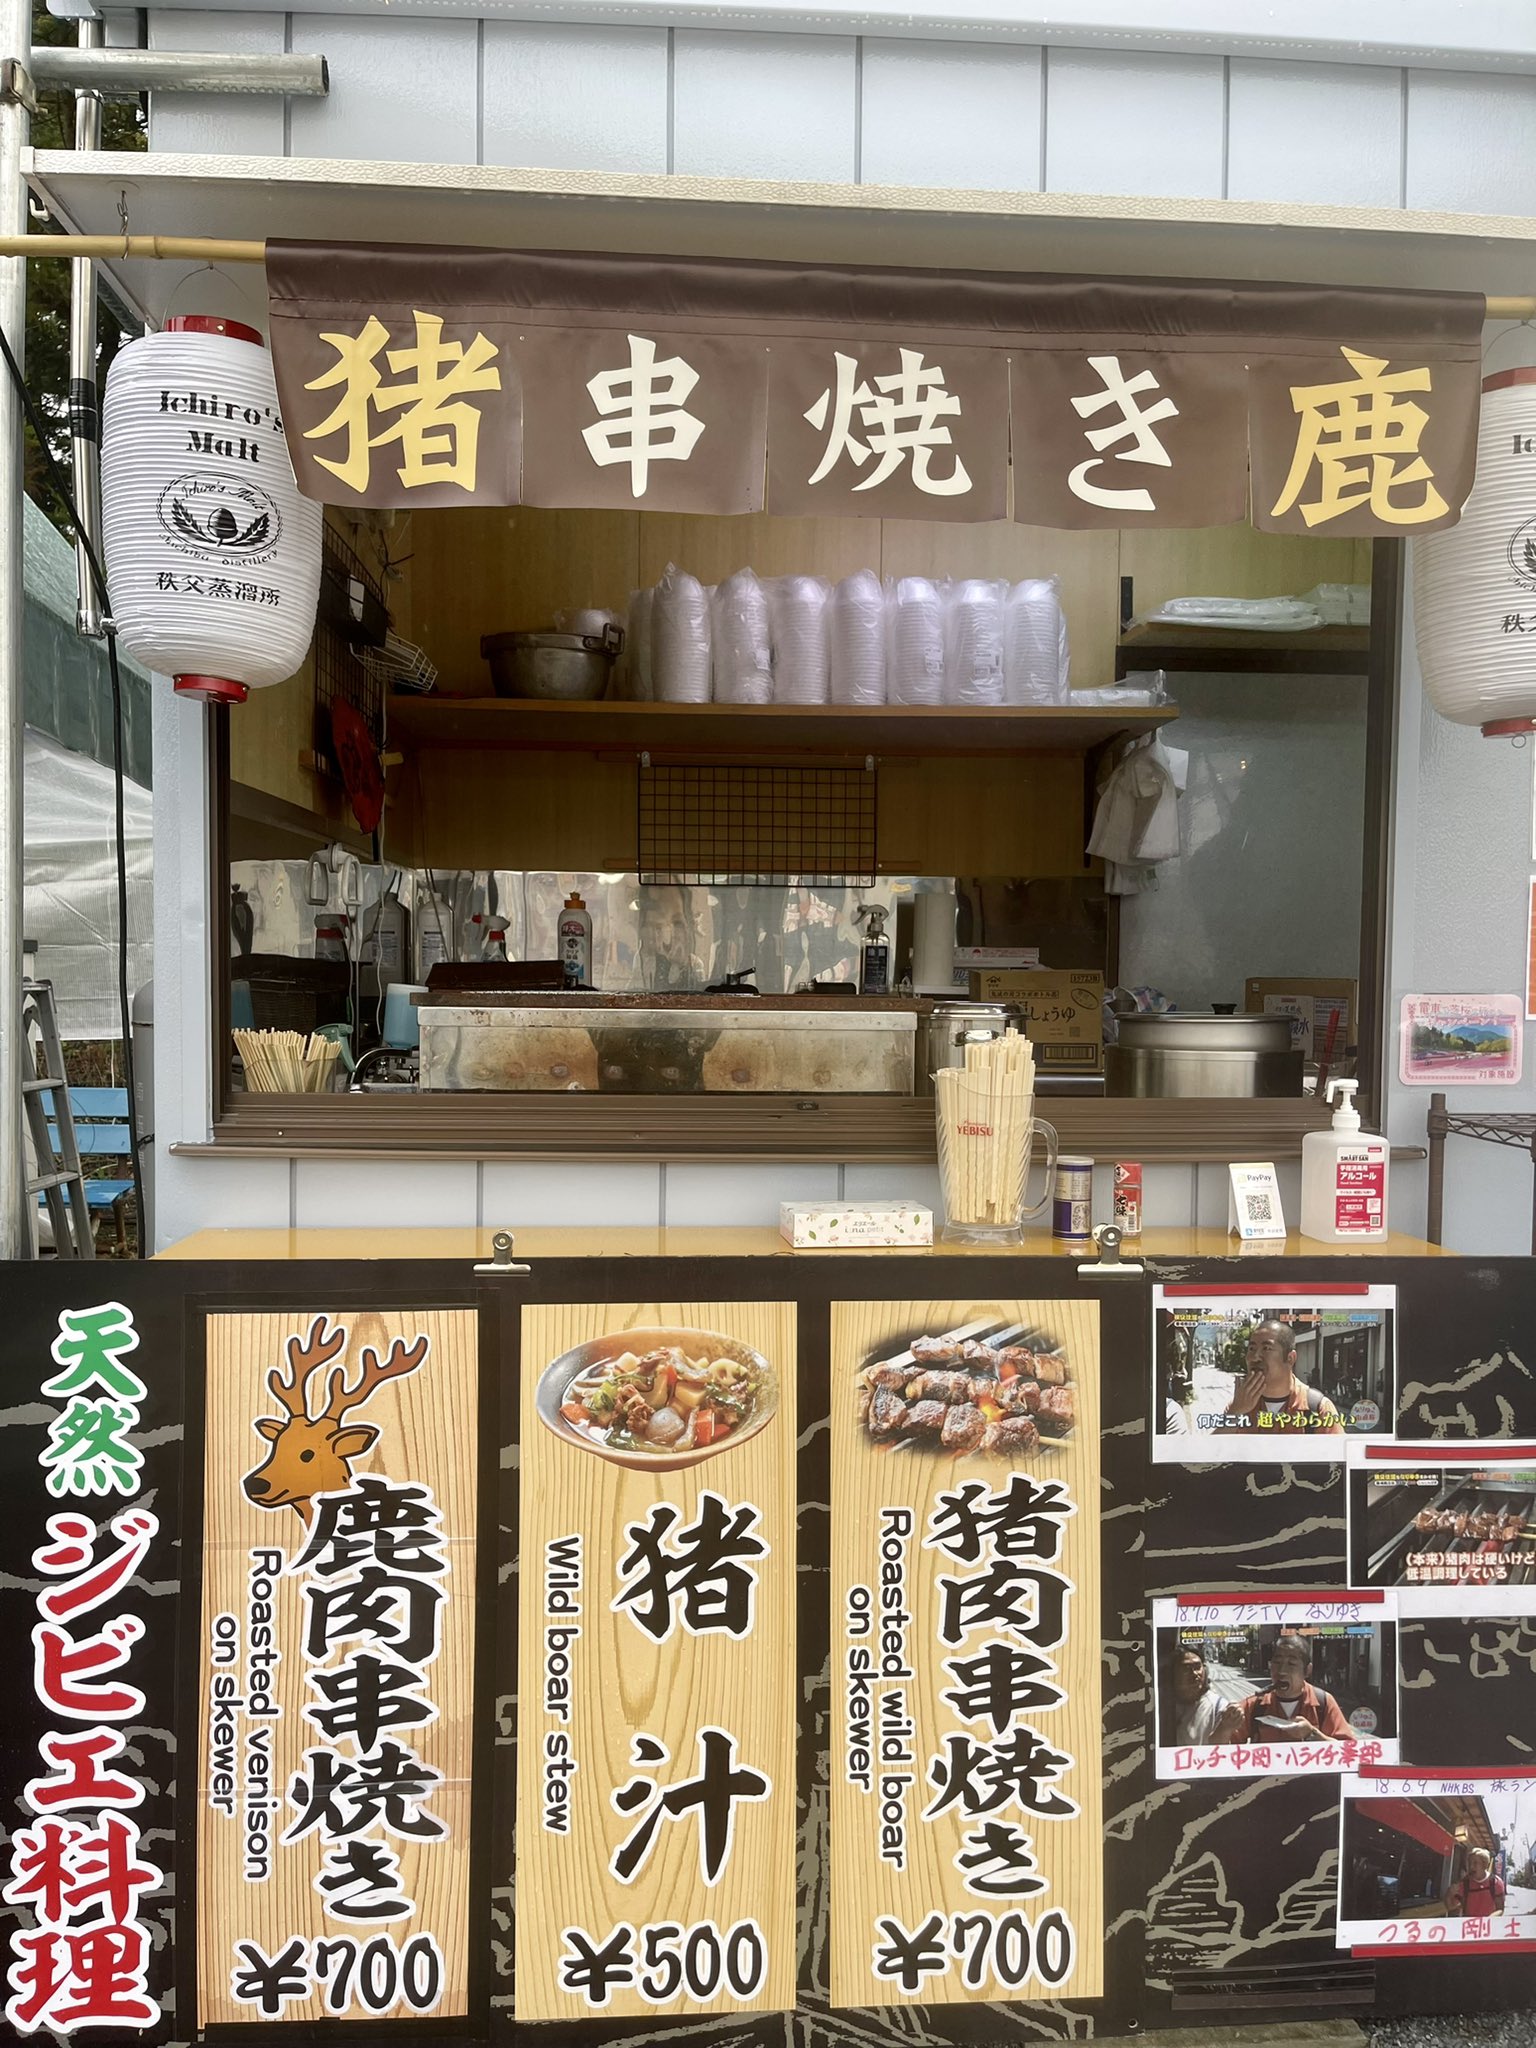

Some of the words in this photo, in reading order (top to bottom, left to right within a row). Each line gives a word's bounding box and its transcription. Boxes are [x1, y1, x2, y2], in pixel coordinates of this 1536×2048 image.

[159, 391, 284, 433] Ichiro's
[186, 430, 260, 463] Malt
[957, 1125, 994, 1137] YEBISU
[1247, 1174, 1272, 1182] PayPay
[1340, 1171, 1377, 1181] アルコール
[1198, 1415, 1252, 1429] 何だこれ
[1257, 1411, 1357, 1429] 超やわらかい
[548, 1538, 579, 1614] Wild
[849, 1587, 870, 1635] on
[881, 1510, 912, 1678] Roasted
[1406, 1566, 1508, 1581] 低温調理している
[215, 1616, 237, 1663] on
[249, 1550, 282, 1716] Roasted
[1175, 1605, 1220, 1623] 18.7.10
[1305, 1602, 1362, 1622] なりゆき
[6, 1304, 162, 2028] 天然ジビエ料理
[287, 1477, 446, 1918] 鹿肉串焼き
[547, 1628, 579, 1720] boar
[616, 1495, 766, 1880] 猪汁
[928, 1477, 1076, 1894] 猪肉串焼き
[213, 1676, 244, 1815] skewer
[849, 1649, 879, 1790] skewer
[882, 1691, 912, 1761] wild
[247, 1729, 278, 1879] venison
[545, 1734, 576, 1831] stew
[882, 1775, 912, 1868] boar
[237, 1938, 439, 2012] ¥700
[563, 1924, 762, 2002] ¥500
[878, 1915, 1070, 1990] ¥700
